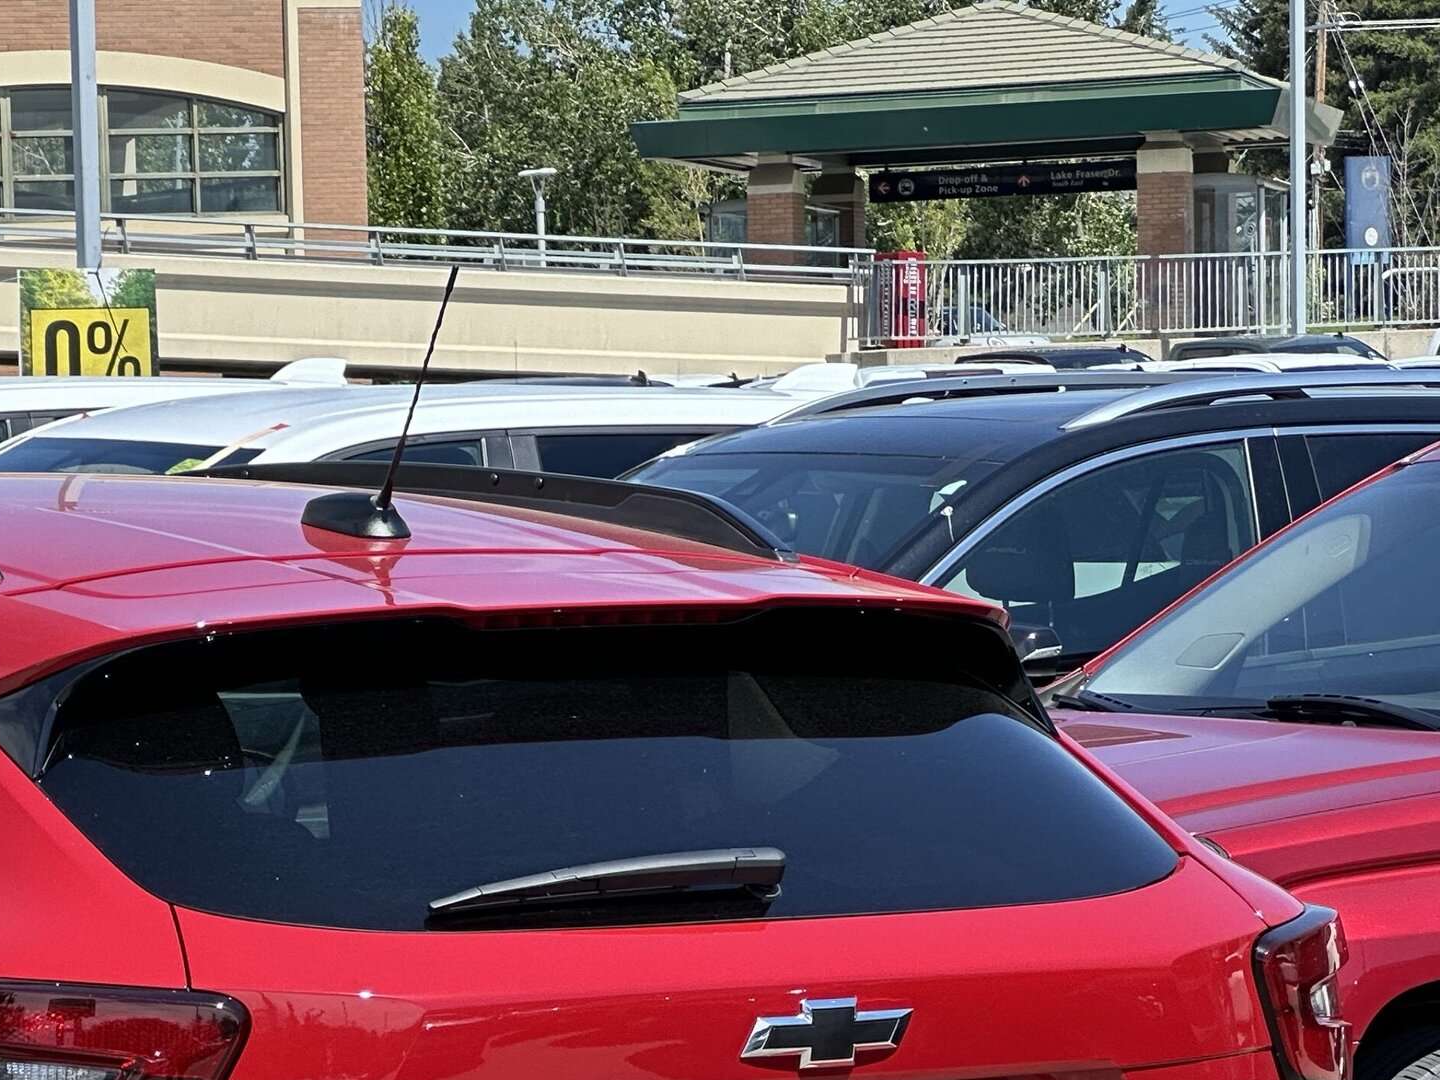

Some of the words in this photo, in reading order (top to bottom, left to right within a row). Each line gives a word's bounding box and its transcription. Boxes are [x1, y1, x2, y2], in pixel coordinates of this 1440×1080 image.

[939, 174, 978, 186] Drop-off
[1050, 170, 1073, 180] Lake
[1076, 169, 1102, 178] Fraser
[939, 185, 972, 195] Pick-up
[975, 184, 999, 193] Zone
[44, 319, 141, 376] 0%
